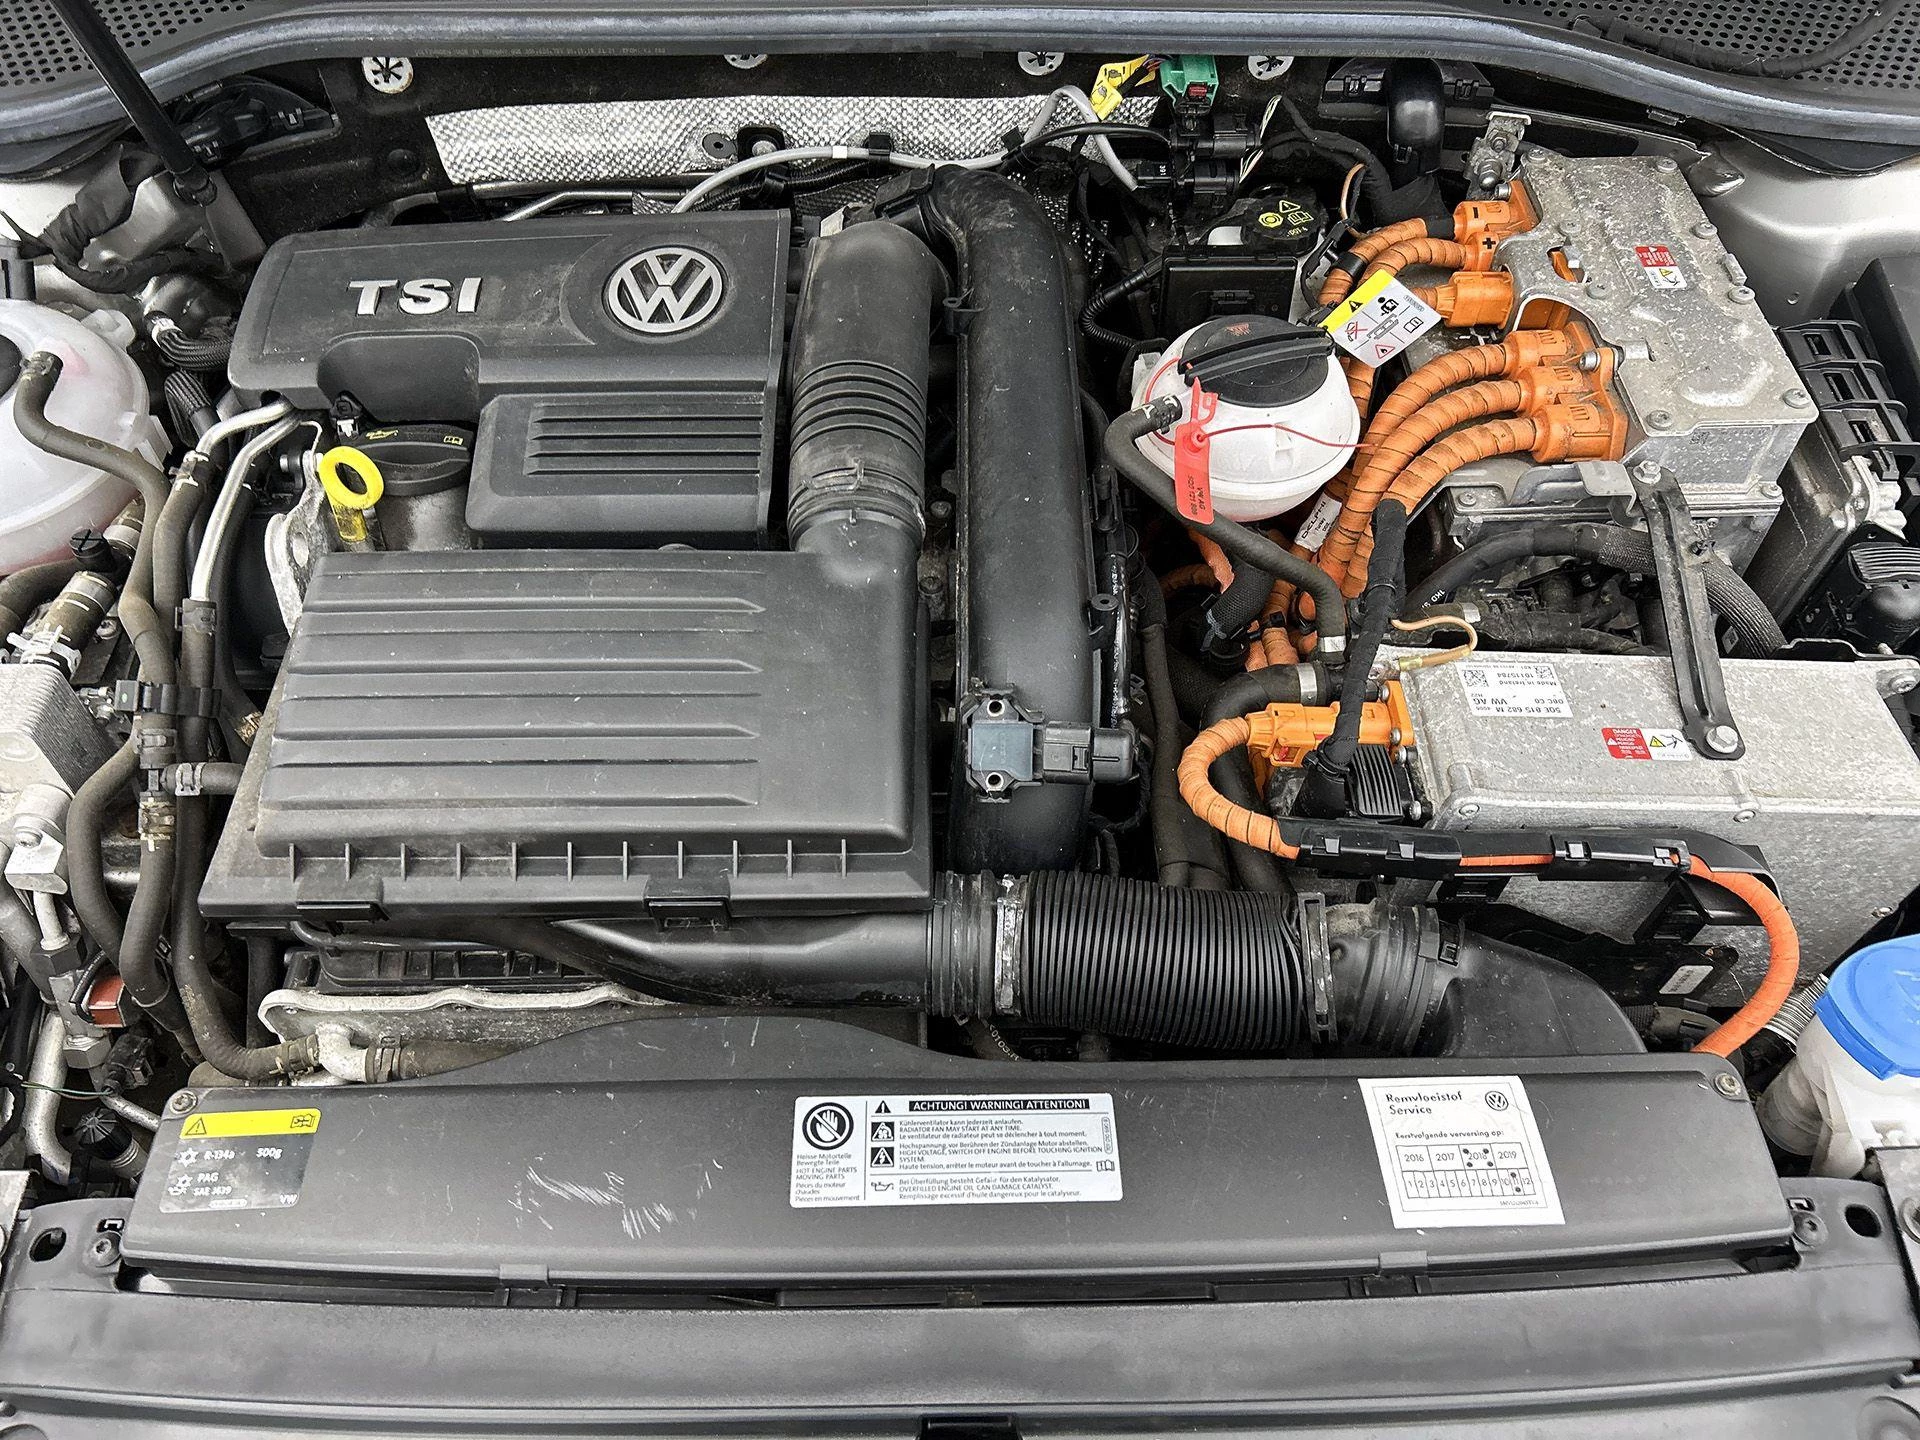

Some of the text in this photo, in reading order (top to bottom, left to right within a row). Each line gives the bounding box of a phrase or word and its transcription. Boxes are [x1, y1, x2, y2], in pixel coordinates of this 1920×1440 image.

[347, 277, 483, 316] TSI
[1301, 501, 1326, 538] DELPHI
[1386, 1090, 1462, 1103] Remvloeistof
[914, 1100, 1086, 1110] ACHTUNG! WARNING! ATTENTION!
[1389, 1104, 1432, 1115] Service
[1404, 1154, 1424, 1162] 2016
[1436, 1153, 1454, 1161] 2017
[1498, 1151, 1517, 1160] 2019
[197, 1172, 219, 1182] PAG
[193, 1187, 210, 1196] SAE
[280, 1194, 297, 1204] VW
